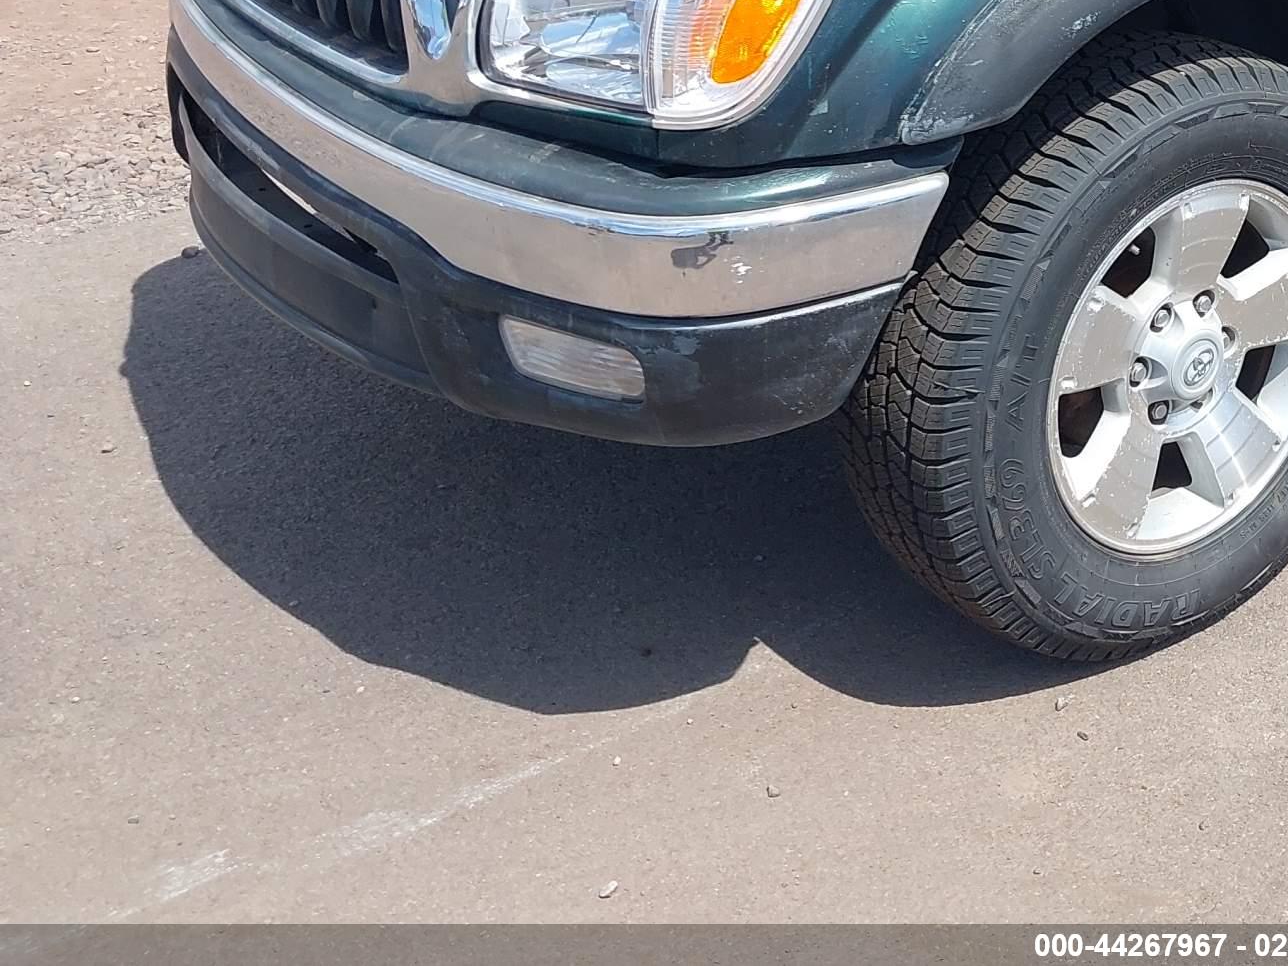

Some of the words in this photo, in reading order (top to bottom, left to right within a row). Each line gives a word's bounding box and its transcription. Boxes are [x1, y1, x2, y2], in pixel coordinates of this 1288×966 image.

[1004, 332, 1039, 432] A/T
[1000, 457, 1056, 580] SL369
[1053, 571, 1201, 627] RADIAL
